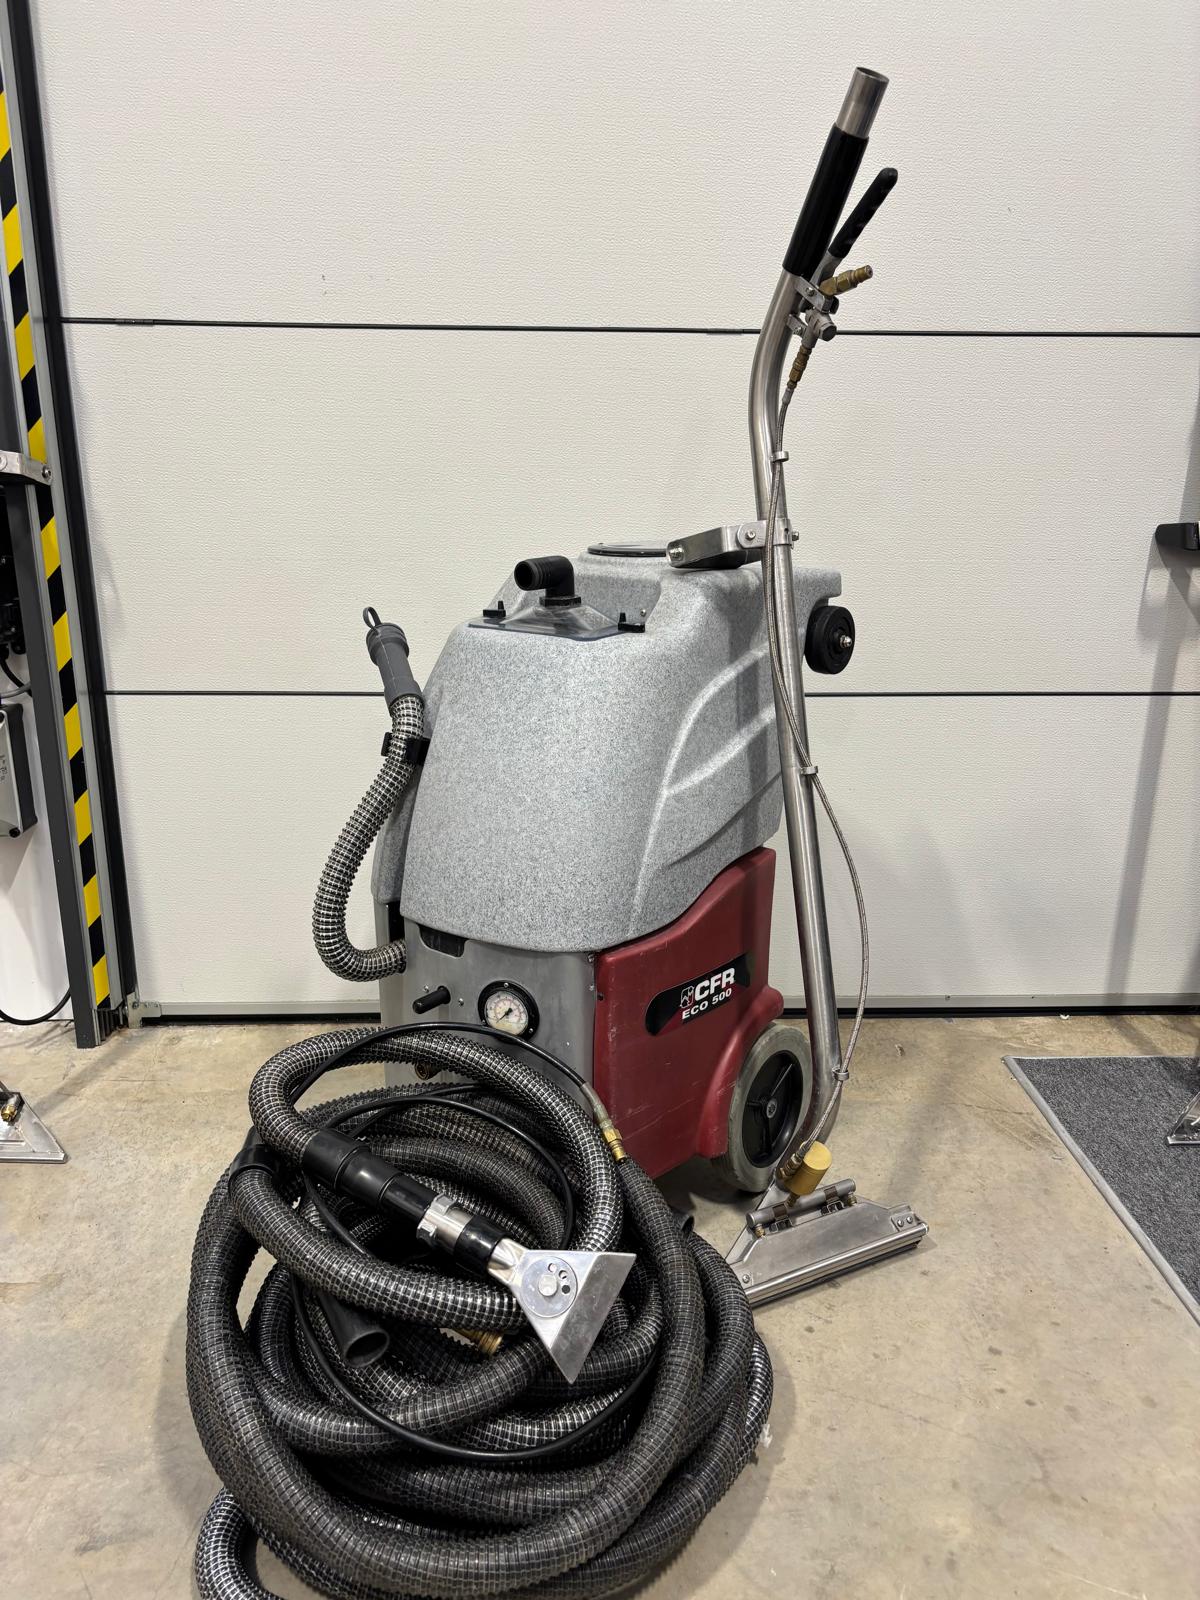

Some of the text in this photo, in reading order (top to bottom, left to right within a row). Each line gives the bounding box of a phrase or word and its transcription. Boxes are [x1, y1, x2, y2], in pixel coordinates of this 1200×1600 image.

[694, 967, 735, 1001] CFR
[682, 988, 732, 1020] ECO 500
